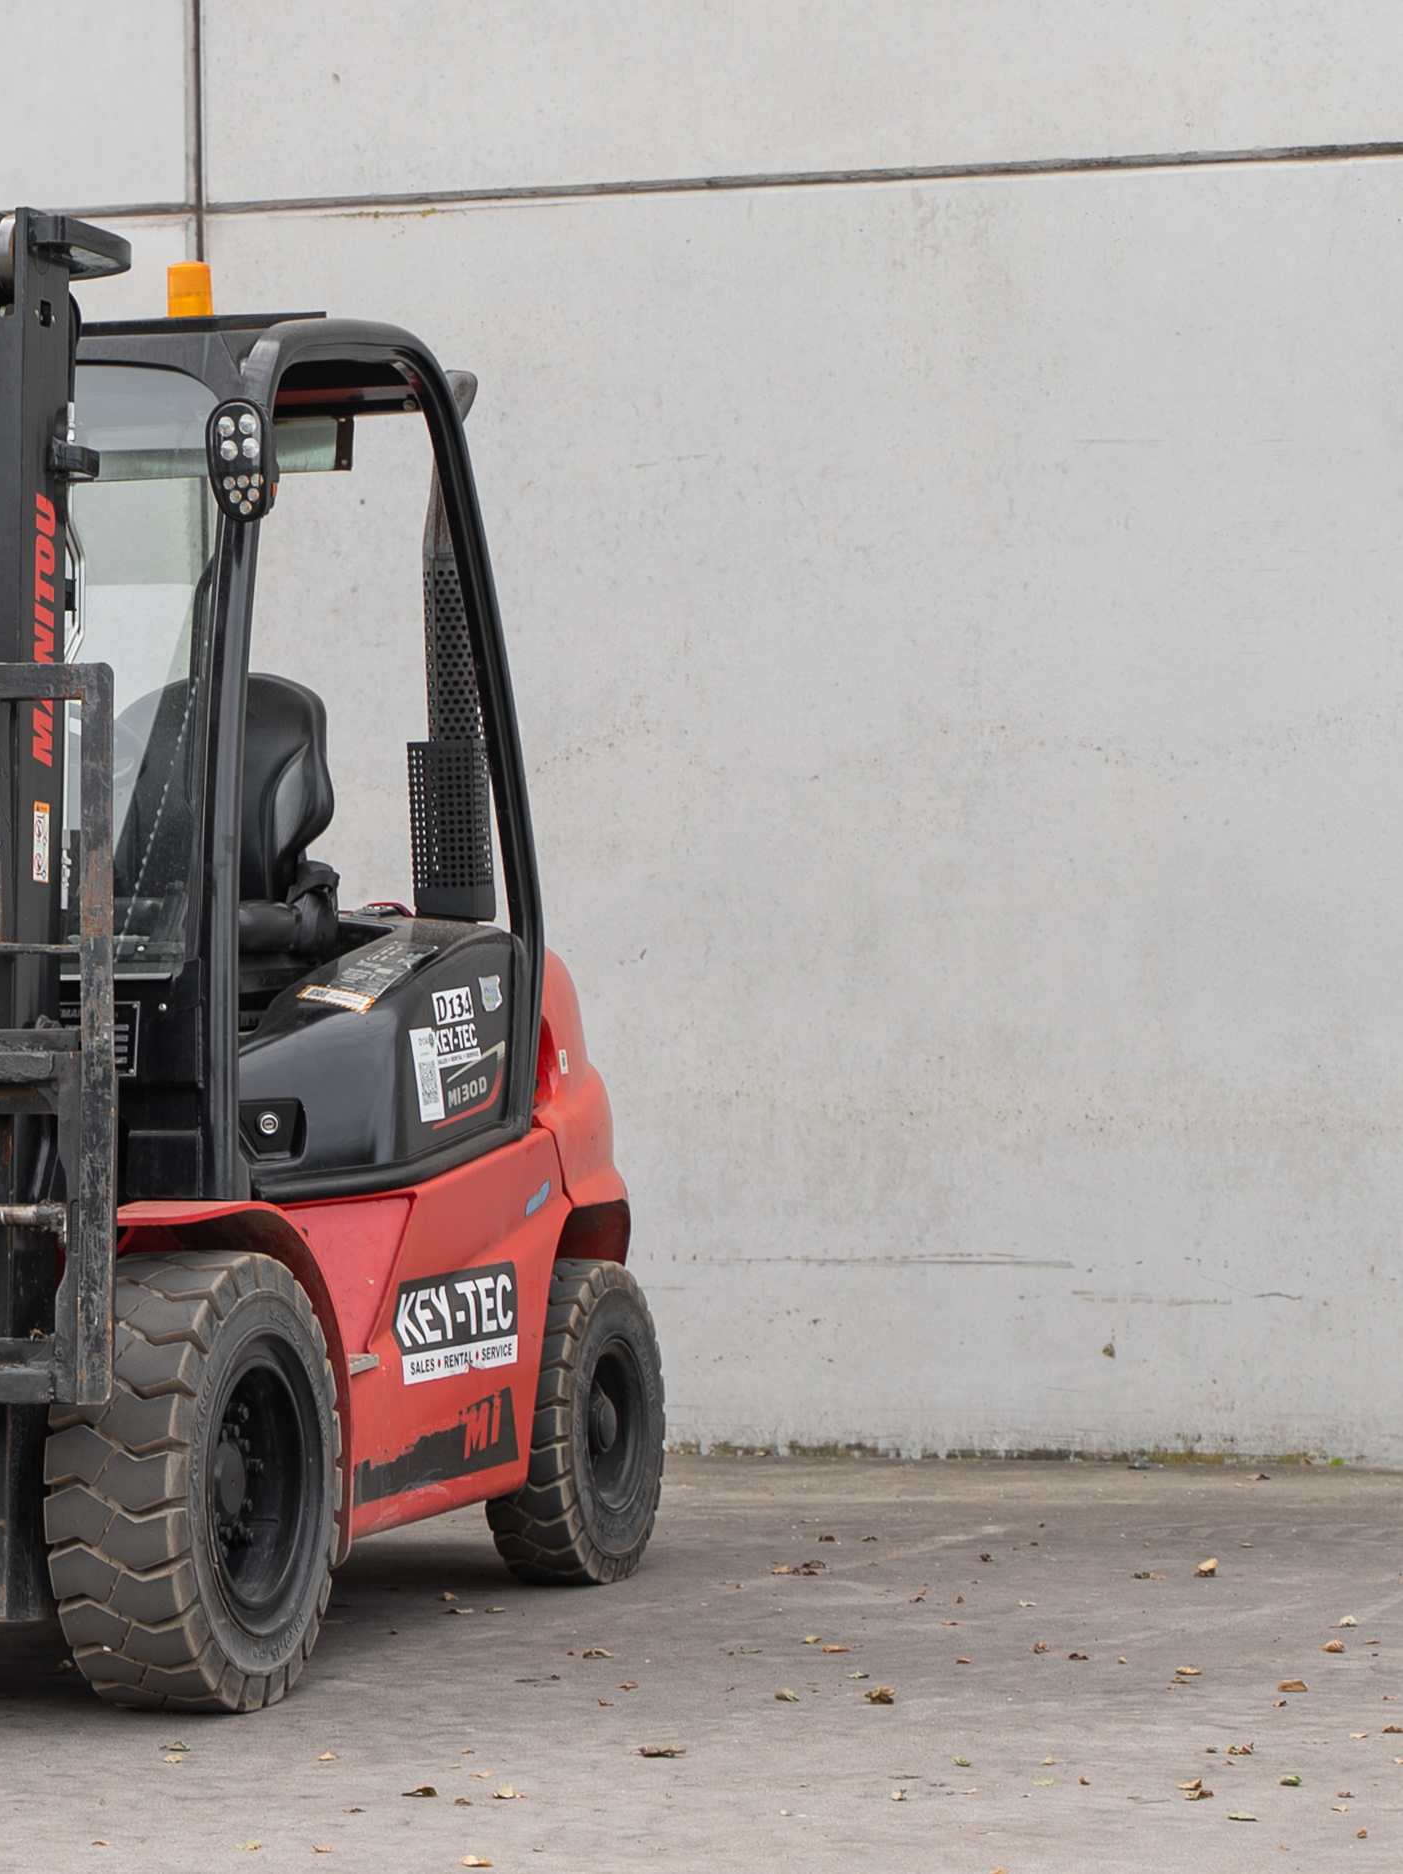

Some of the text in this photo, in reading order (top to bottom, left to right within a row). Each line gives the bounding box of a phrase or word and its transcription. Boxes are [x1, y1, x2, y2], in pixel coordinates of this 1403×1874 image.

[32, 493, 56, 768] MNITOU
[436, 990, 472, 1022] D134
[396, 1273, 514, 1348] KEY-TEC
[410, 1343, 513, 1376] SALES RENTAL SERVICE
